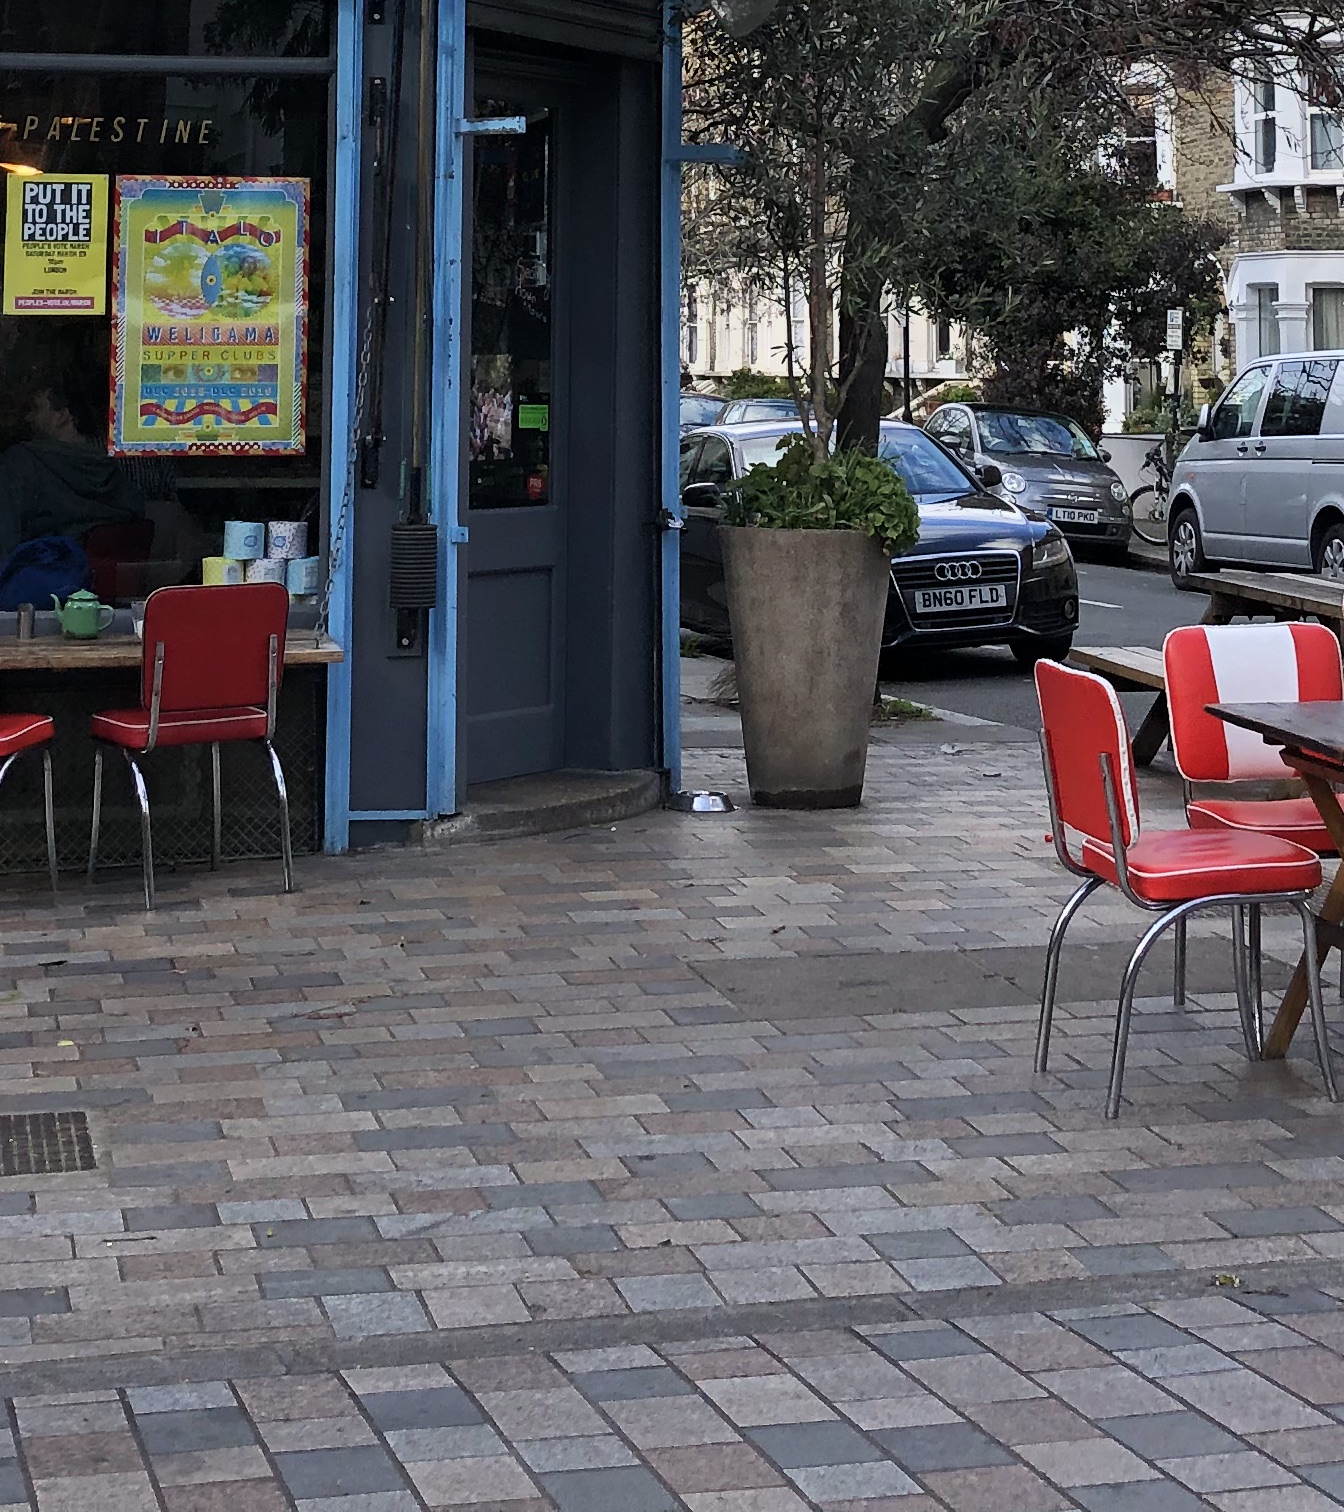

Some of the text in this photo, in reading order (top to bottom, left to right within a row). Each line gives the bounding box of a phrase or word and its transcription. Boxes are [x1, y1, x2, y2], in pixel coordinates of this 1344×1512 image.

[22, 114, 214, 145] PALESTINE
[24, 183, 91, 205] PUT IT
[24, 204, 91, 224] TO THE
[23, 223, 91, 241] PEOPLE
[147, 326, 277, 344] WELIGAMA
[143, 350, 277, 361] SUPPER CLUBS
[921, 587, 1000, 608] BN60 FLD
